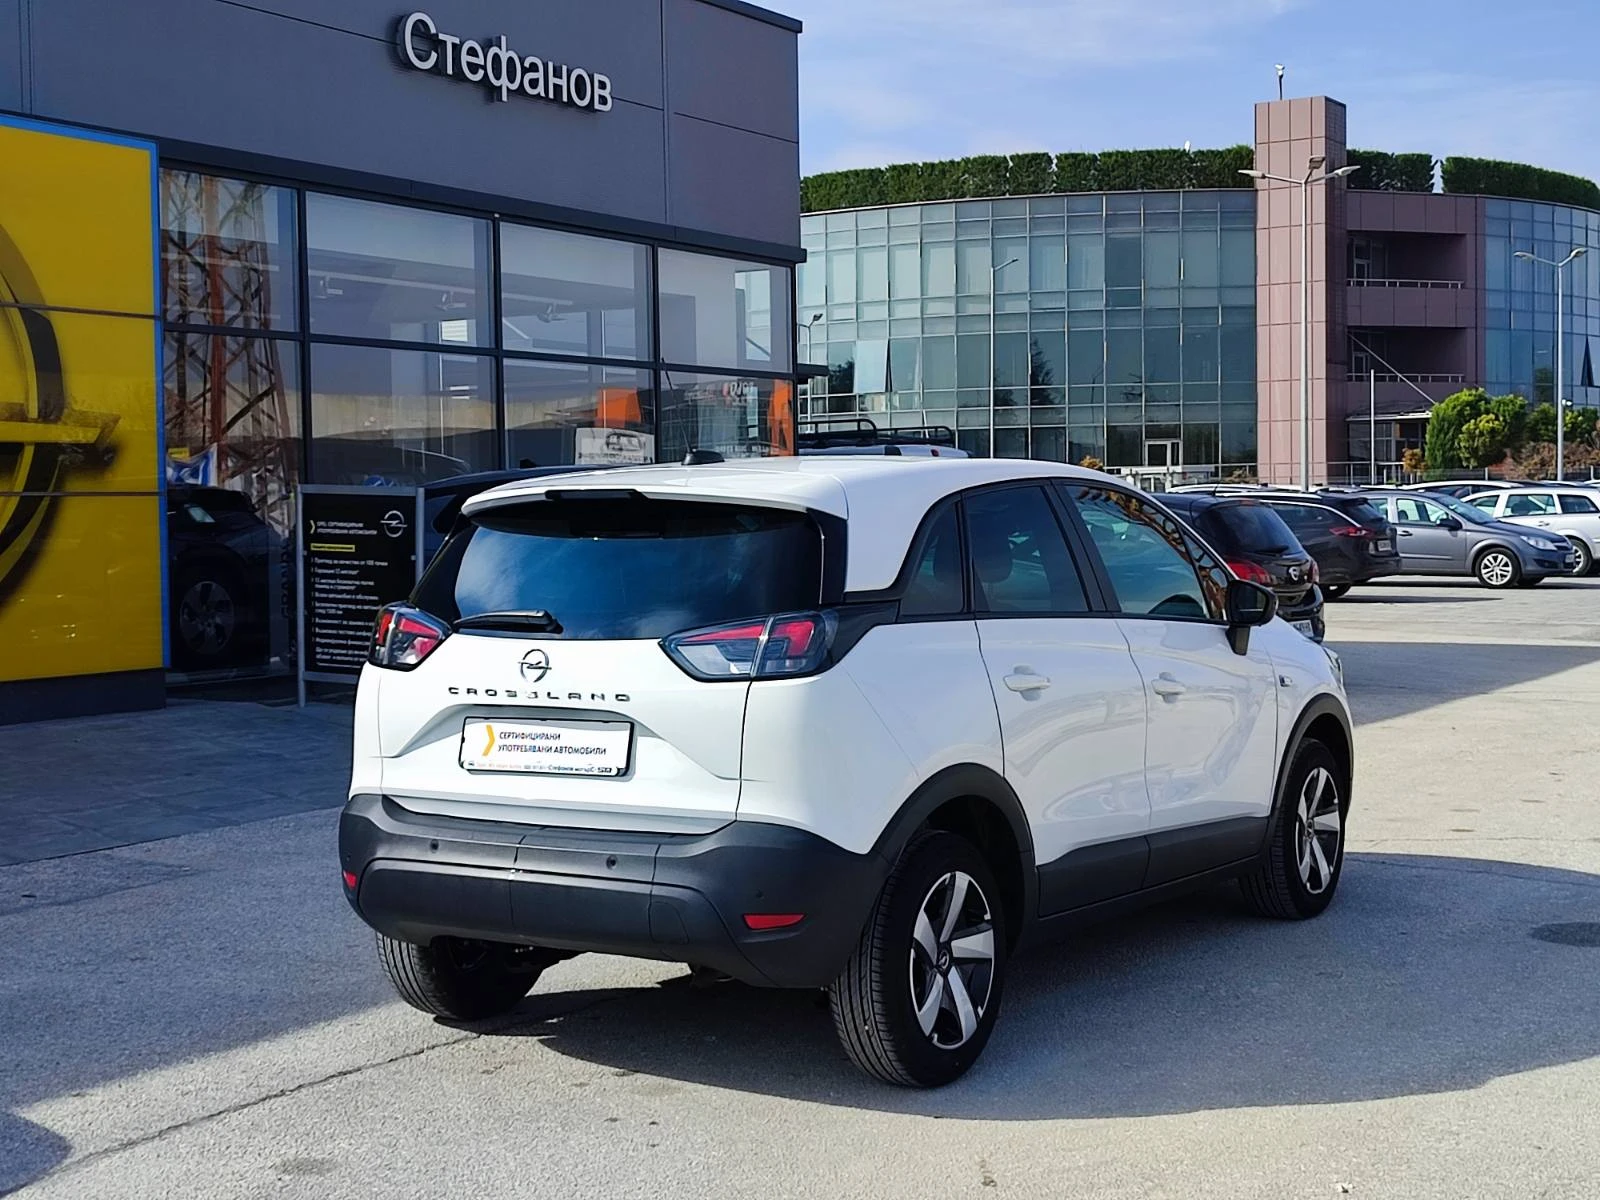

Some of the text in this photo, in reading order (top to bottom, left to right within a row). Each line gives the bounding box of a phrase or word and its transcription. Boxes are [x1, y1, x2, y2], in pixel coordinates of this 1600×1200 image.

[404, 12, 612, 112] Стефанов
[499, 731, 561, 741] СЕРТИФИЦИРАНИ
[498, 744, 607, 755] УПОТРЕБЯВАНИ АВТОМОБИЛИ
